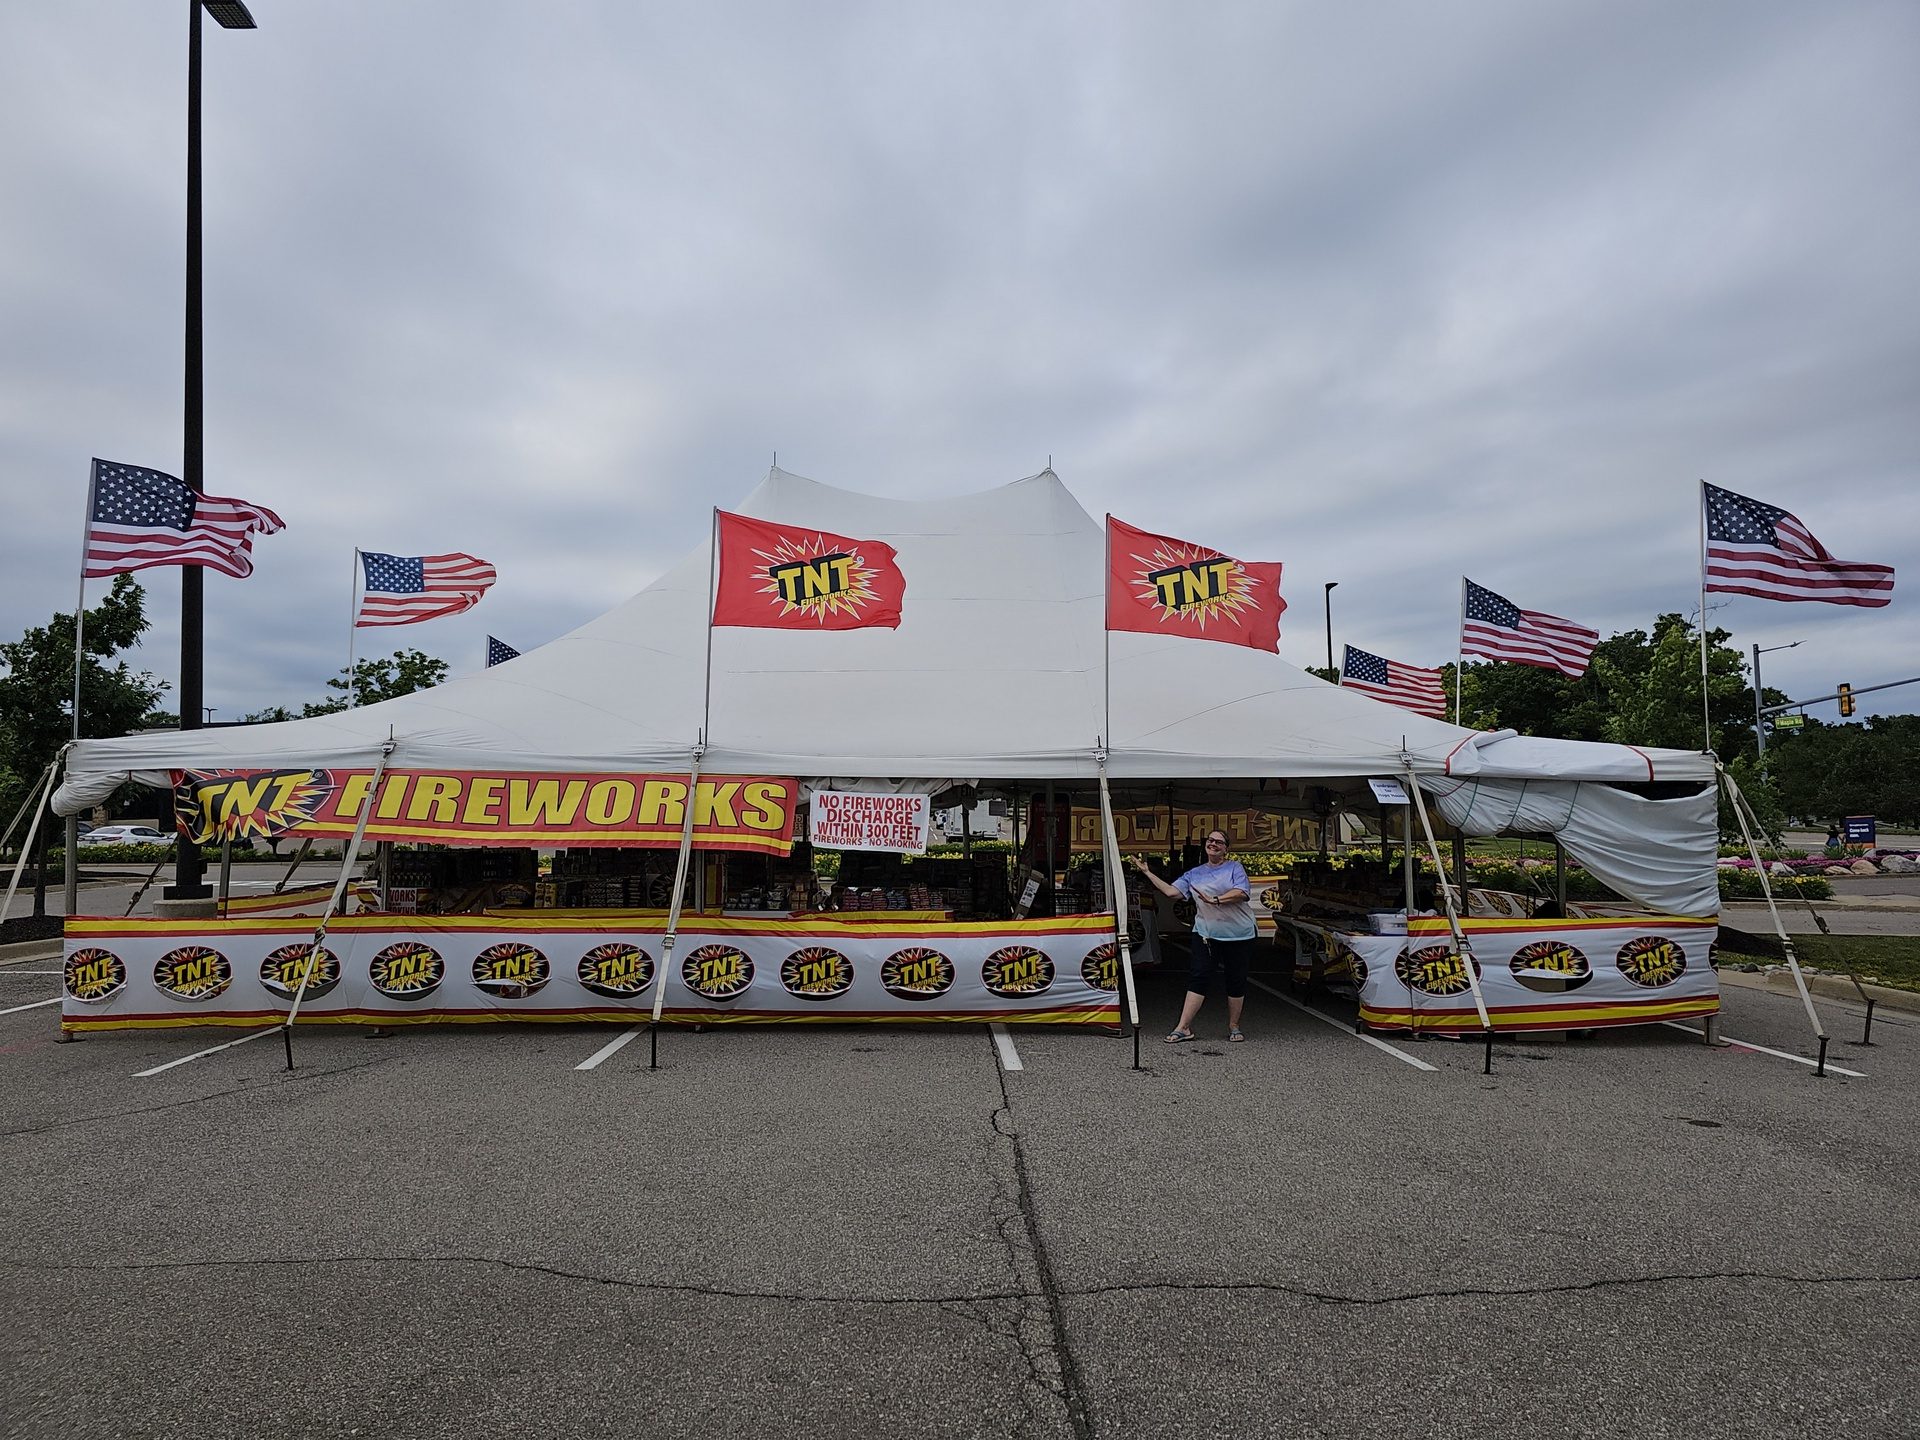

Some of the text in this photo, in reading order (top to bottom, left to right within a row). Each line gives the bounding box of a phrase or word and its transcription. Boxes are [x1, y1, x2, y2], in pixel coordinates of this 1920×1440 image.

[777, 556, 854, 603] TNT
[1156, 561, 1234, 607] TNT
[800, 589, 853, 606] FIREWORKS
[1179, 593, 1233, 611] FIREWORKS
[197, 771, 313, 836] TNT
[335, 773, 788, 831] FIREWORKS
[819, 794, 922, 812] NO FIREWORKS
[817, 821, 863, 838] WITHIN
[866, 824, 889, 839] 300
[892, 824, 921, 841] FEET
[826, 808, 913, 826] DISCHARGE
[813, 834, 863, 846] FIREWORKS
[869, 838, 882, 847] NO
[883, 839, 923, 850] SMOKING
[75, 957, 113, 986] TNT
[173, 954, 218, 985] TNT
[281, 952, 325, 982] TNT
[387, 951, 433, 980] TNT
[493, 952, 535, 980] TNT
[598, 952, 641, 980] TNT
[700, 954, 740, 982] TNT
[799, 956, 839, 985] TNT
[900, 955, 940, 985] TNT
[1001, 954, 1041, 983] TNT
[1423, 955, 1463, 982] TNT
[1530, 948, 1572, 971] TNT
[1635, 943, 1670, 974] TNT
[386, 969, 432, 989] FIREWORKS
[700, 972, 742, 990] FIREWORKS
